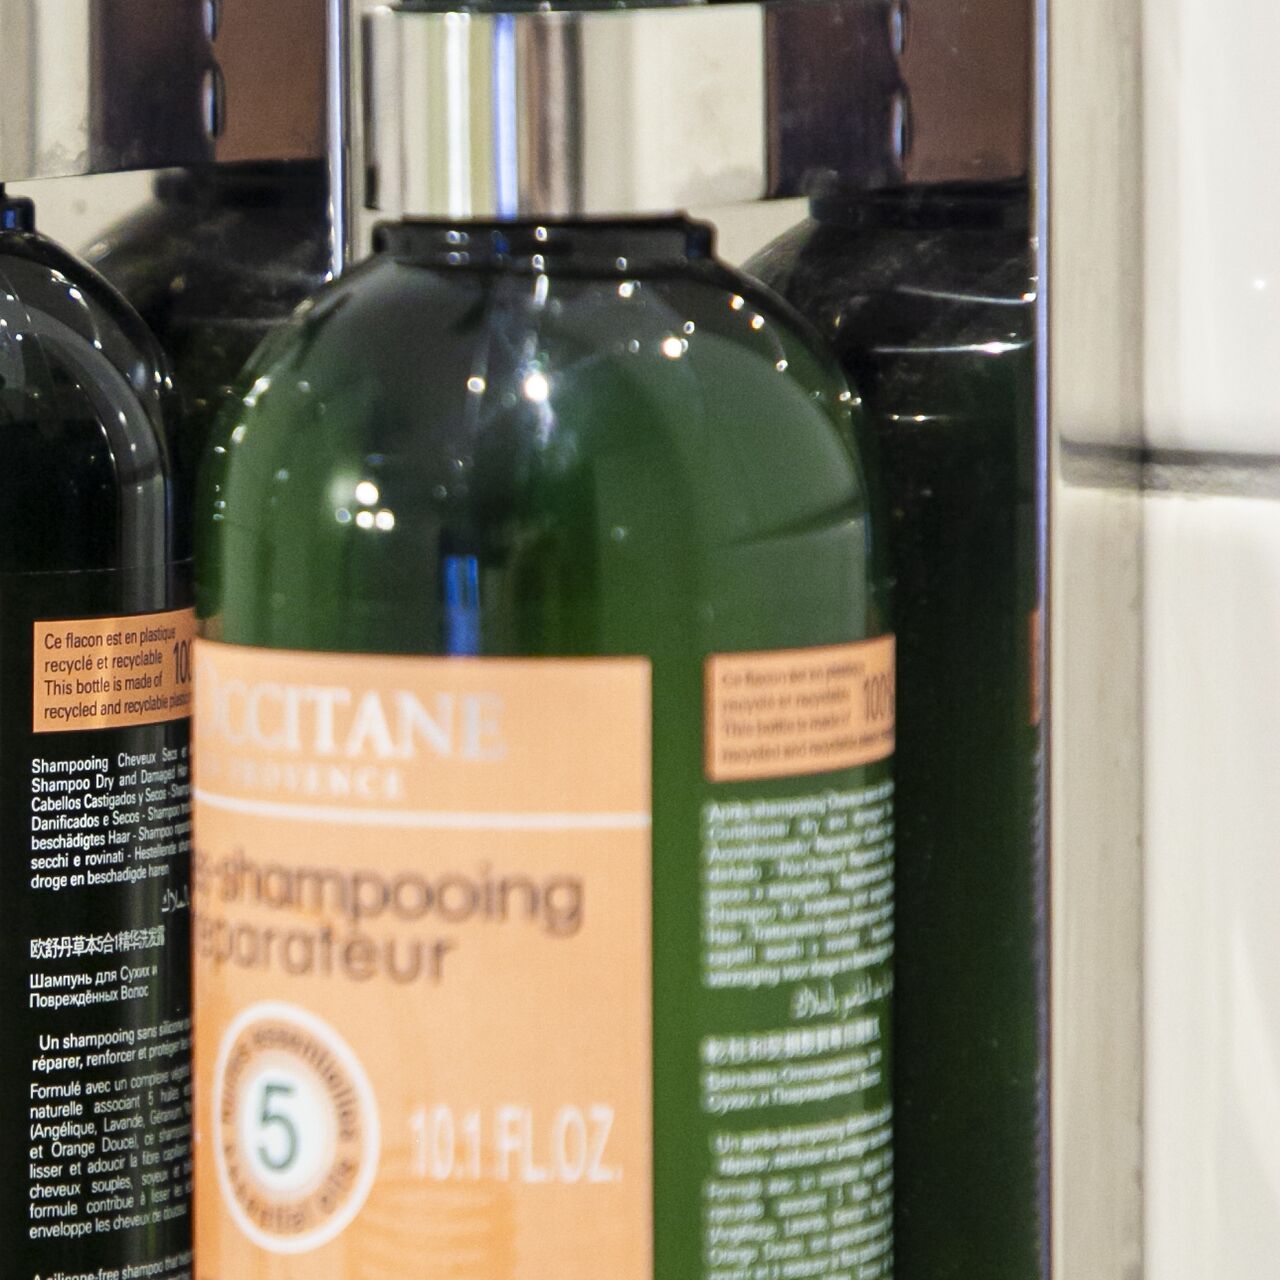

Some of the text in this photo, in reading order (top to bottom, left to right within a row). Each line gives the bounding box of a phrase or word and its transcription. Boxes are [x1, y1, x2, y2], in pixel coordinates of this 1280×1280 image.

[44, 633, 62, 649] Ce
[66, 632, 103, 648] flacon
[106, 633, 122, 646] est
[125, 632, 137, 645] en
[45, 650, 163, 675] recyclé et recyclable
[44, 671, 163, 696] This bottle is made of
[44, 701, 97, 721] recycled
[100, 699, 121, 716] and
[32, 752, 156, 774] Shampooing Cheveux
[32, 778, 90, 794] Shampoo
[96, 774, 114, 791] Dry
[119, 771, 137, 786] and
[32, 796, 81, 812] Cabellos
[84, 791, 136, 811] Castigados
[138, 792, 144, 806] y
[145, 788, 167, 802] Secos
[32, 810, 140, 831] Danificados e Secos
[32, 830, 131, 850] beschädigtes Haar
[31, 848, 124, 870] secchi e rovinati
[31, 866, 147, 891] droge en beschadigde
[30, 973, 92, 989] Шампунь
[95, 970, 117, 986] для
[121, 984, 149, 1000] Волос
[39, 1026, 158, 1051] Un shampooing sans
[32, 1046, 147, 1074] réparer, renforcer et
[31, 1080, 81, 1099] Formulé
[85, 1080, 111, 1095] avec
[114, 1078, 127, 1090] un
[30, 1091, 153, 1119] naturelle associant 5
[30, 1120, 97, 1141] (Angélique,
[256, 1084, 297, 1173] 5
[29, 1145, 43, 1159] et
[51, 1142, 95, 1158] Orange
[410, 1105, 481, 1181] 10.1
[29, 1163, 63, 1179] lisser
[70, 1162, 82, 1176] et
[87, 1158, 126, 1174] adoucir
[130, 1153, 137, 1168] la
[29, 1176, 133, 1199] cheveux souples,
[29, 1195, 134, 1219] formule contribue
[29, 1220, 93, 1239] enveloppe
[95, 1218, 110, 1232] les
[113, 1213, 149, 1230] cheveux
[121, 1263, 163, 1280] shampoo
